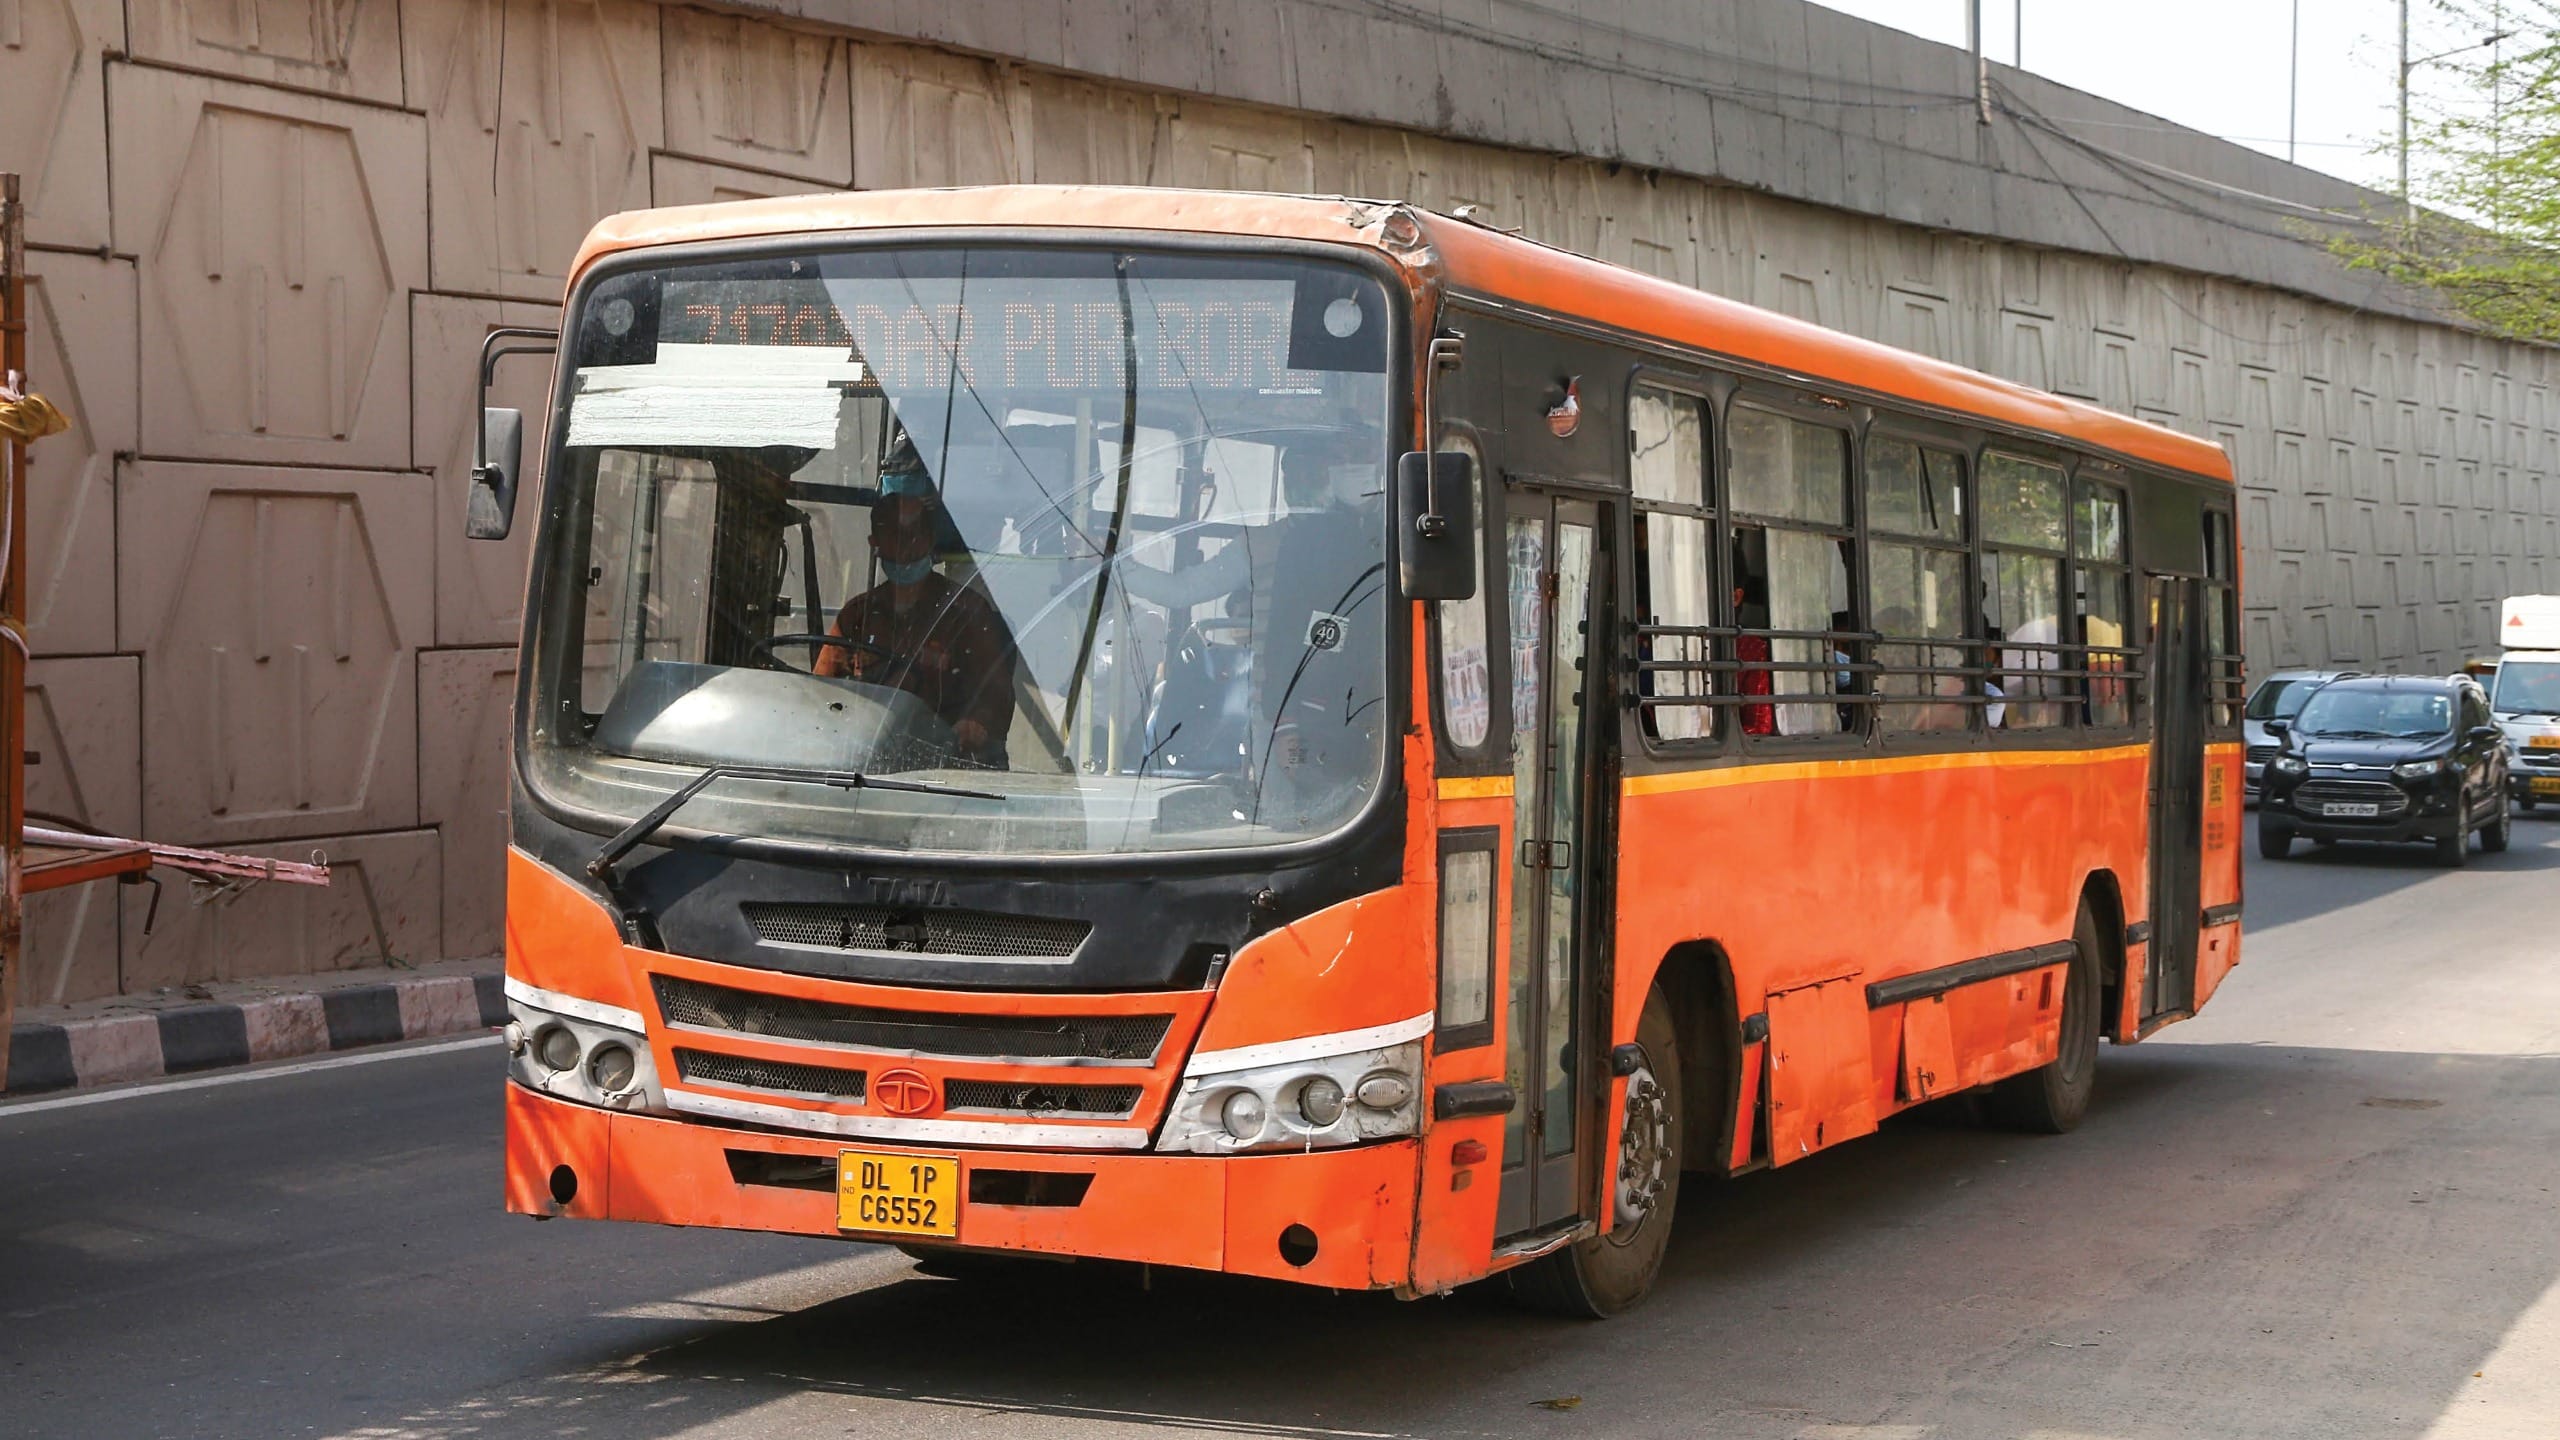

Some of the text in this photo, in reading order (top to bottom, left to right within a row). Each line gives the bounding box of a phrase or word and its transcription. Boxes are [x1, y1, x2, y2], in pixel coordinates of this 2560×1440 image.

[1005, 302, 1126, 388] PUR
[1317, 626, 1335, 640] 40
[867, 876, 957, 908] TATA
[841, 1186, 855, 1195] IND
[861, 1161, 937, 1194] DL 1P
[860, 1193, 937, 1228] C6552
